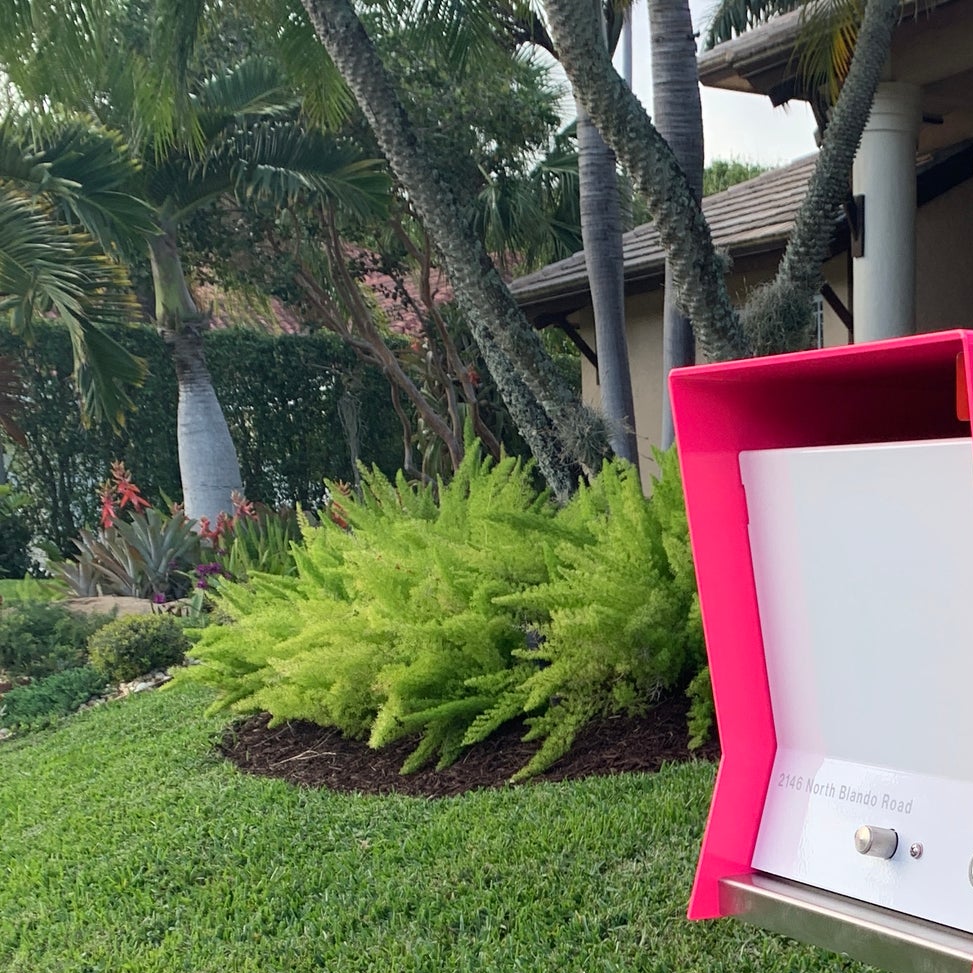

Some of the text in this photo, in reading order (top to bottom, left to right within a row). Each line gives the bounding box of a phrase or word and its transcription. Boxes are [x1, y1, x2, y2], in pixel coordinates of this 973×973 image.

[778, 773, 913, 814] 2146 North Blando Road
